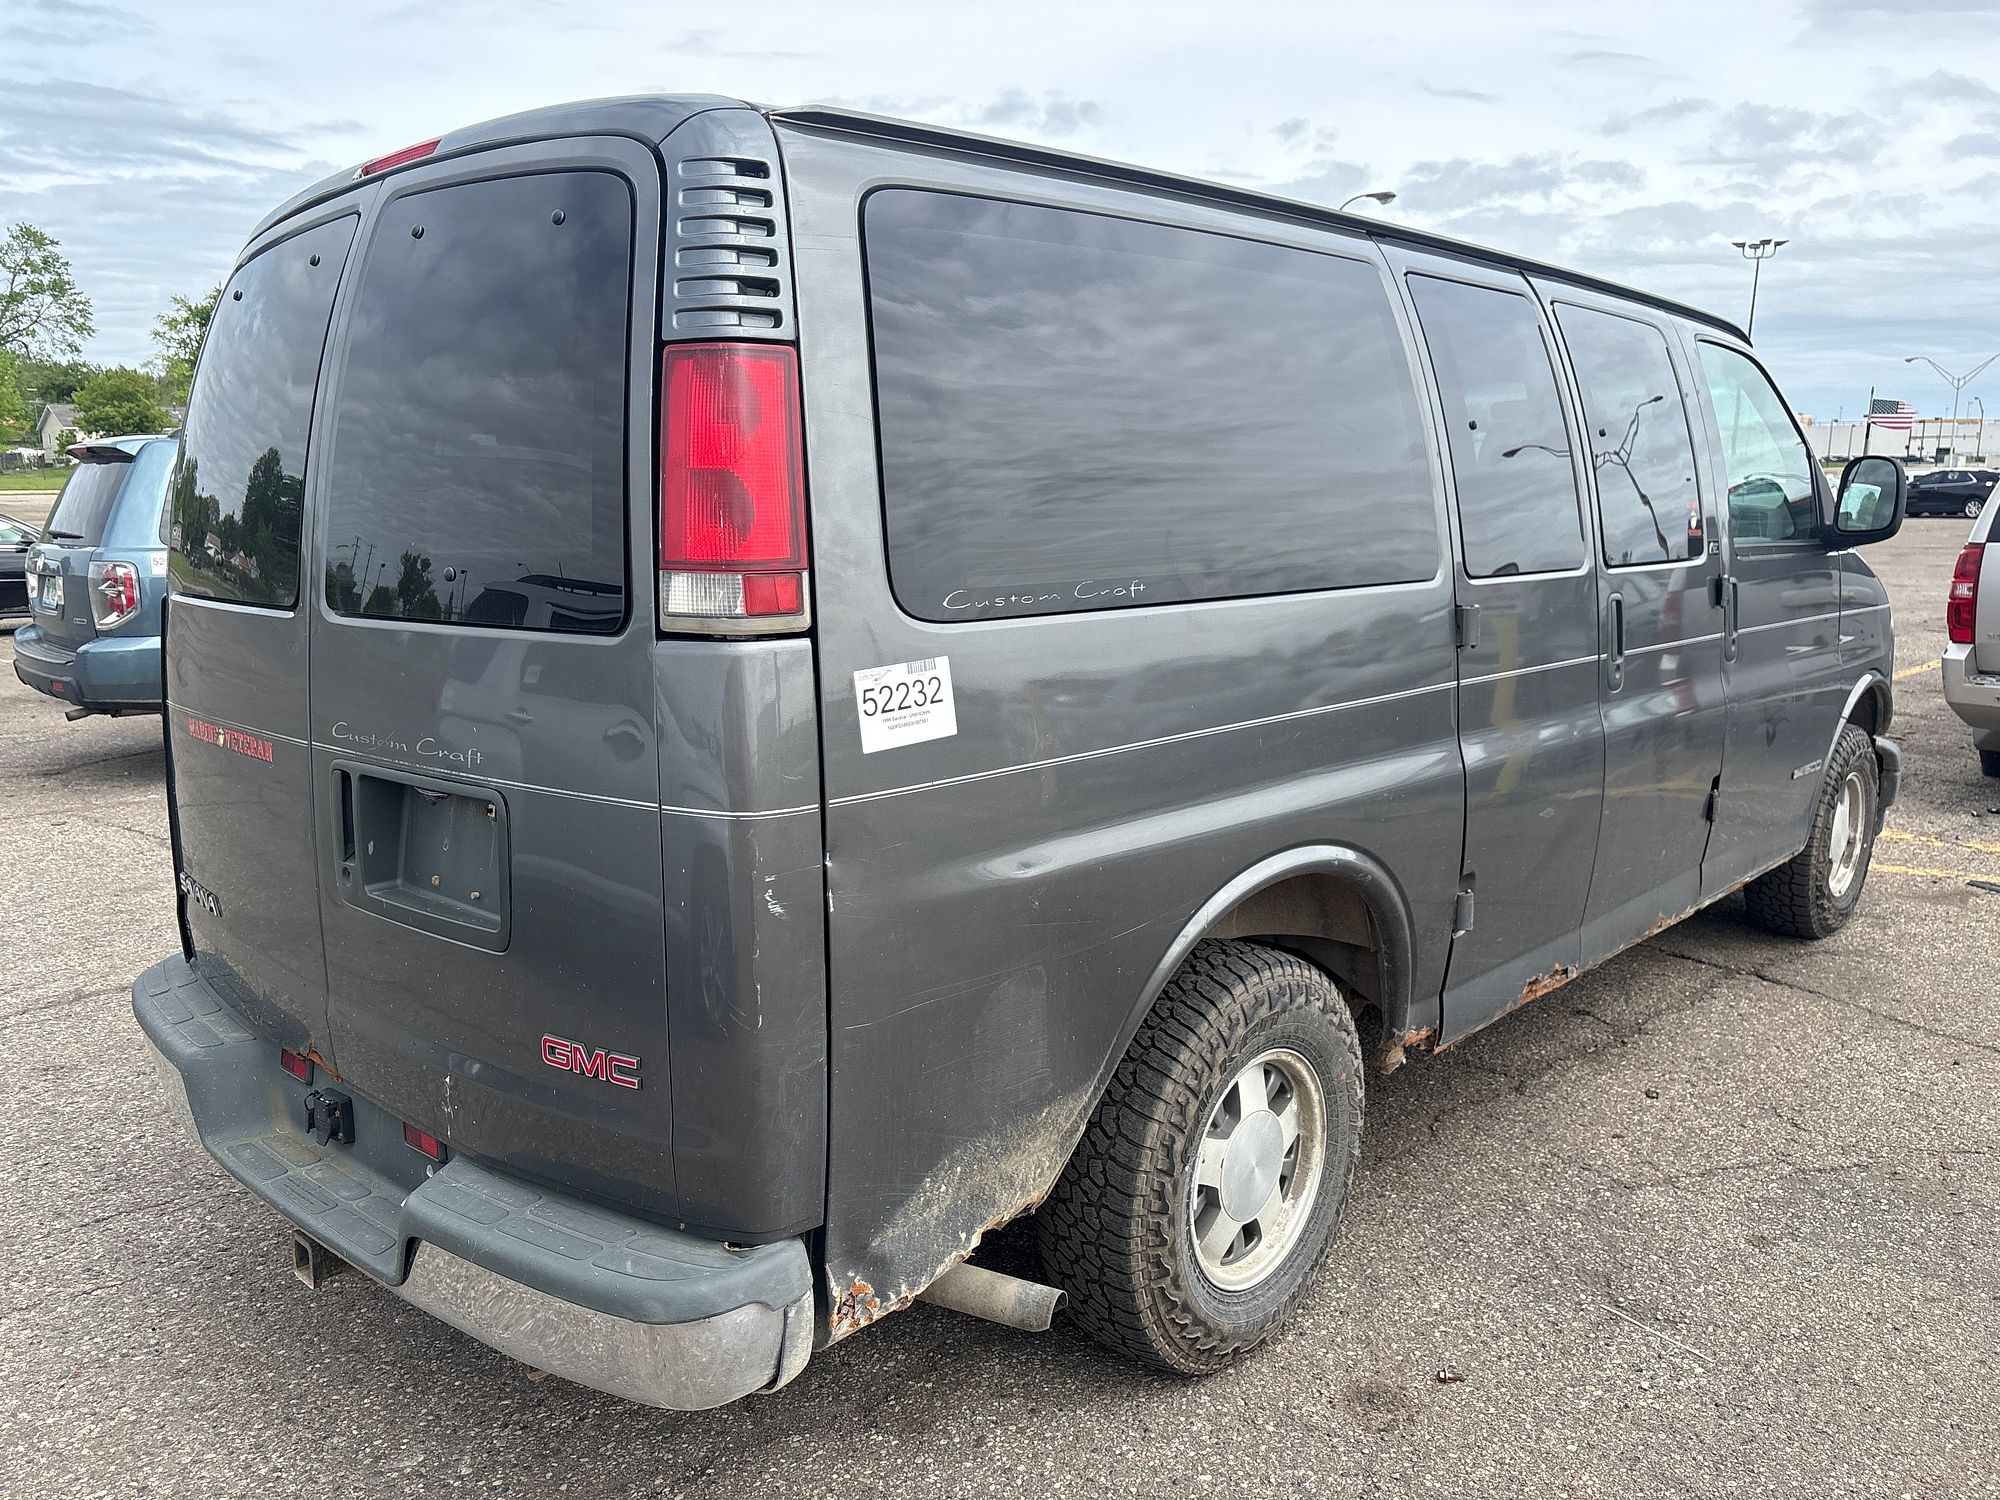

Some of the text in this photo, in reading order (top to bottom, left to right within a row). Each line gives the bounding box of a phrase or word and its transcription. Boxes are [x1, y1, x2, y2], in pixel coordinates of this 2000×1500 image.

[942, 580, 1146, 609] Custom Craft
[863, 676, 943, 717] 52232
[224, 728, 273, 763] VETERAN
[332, 721, 484, 769] Custom Craft
[541, 1033, 643, 1090] GMC
